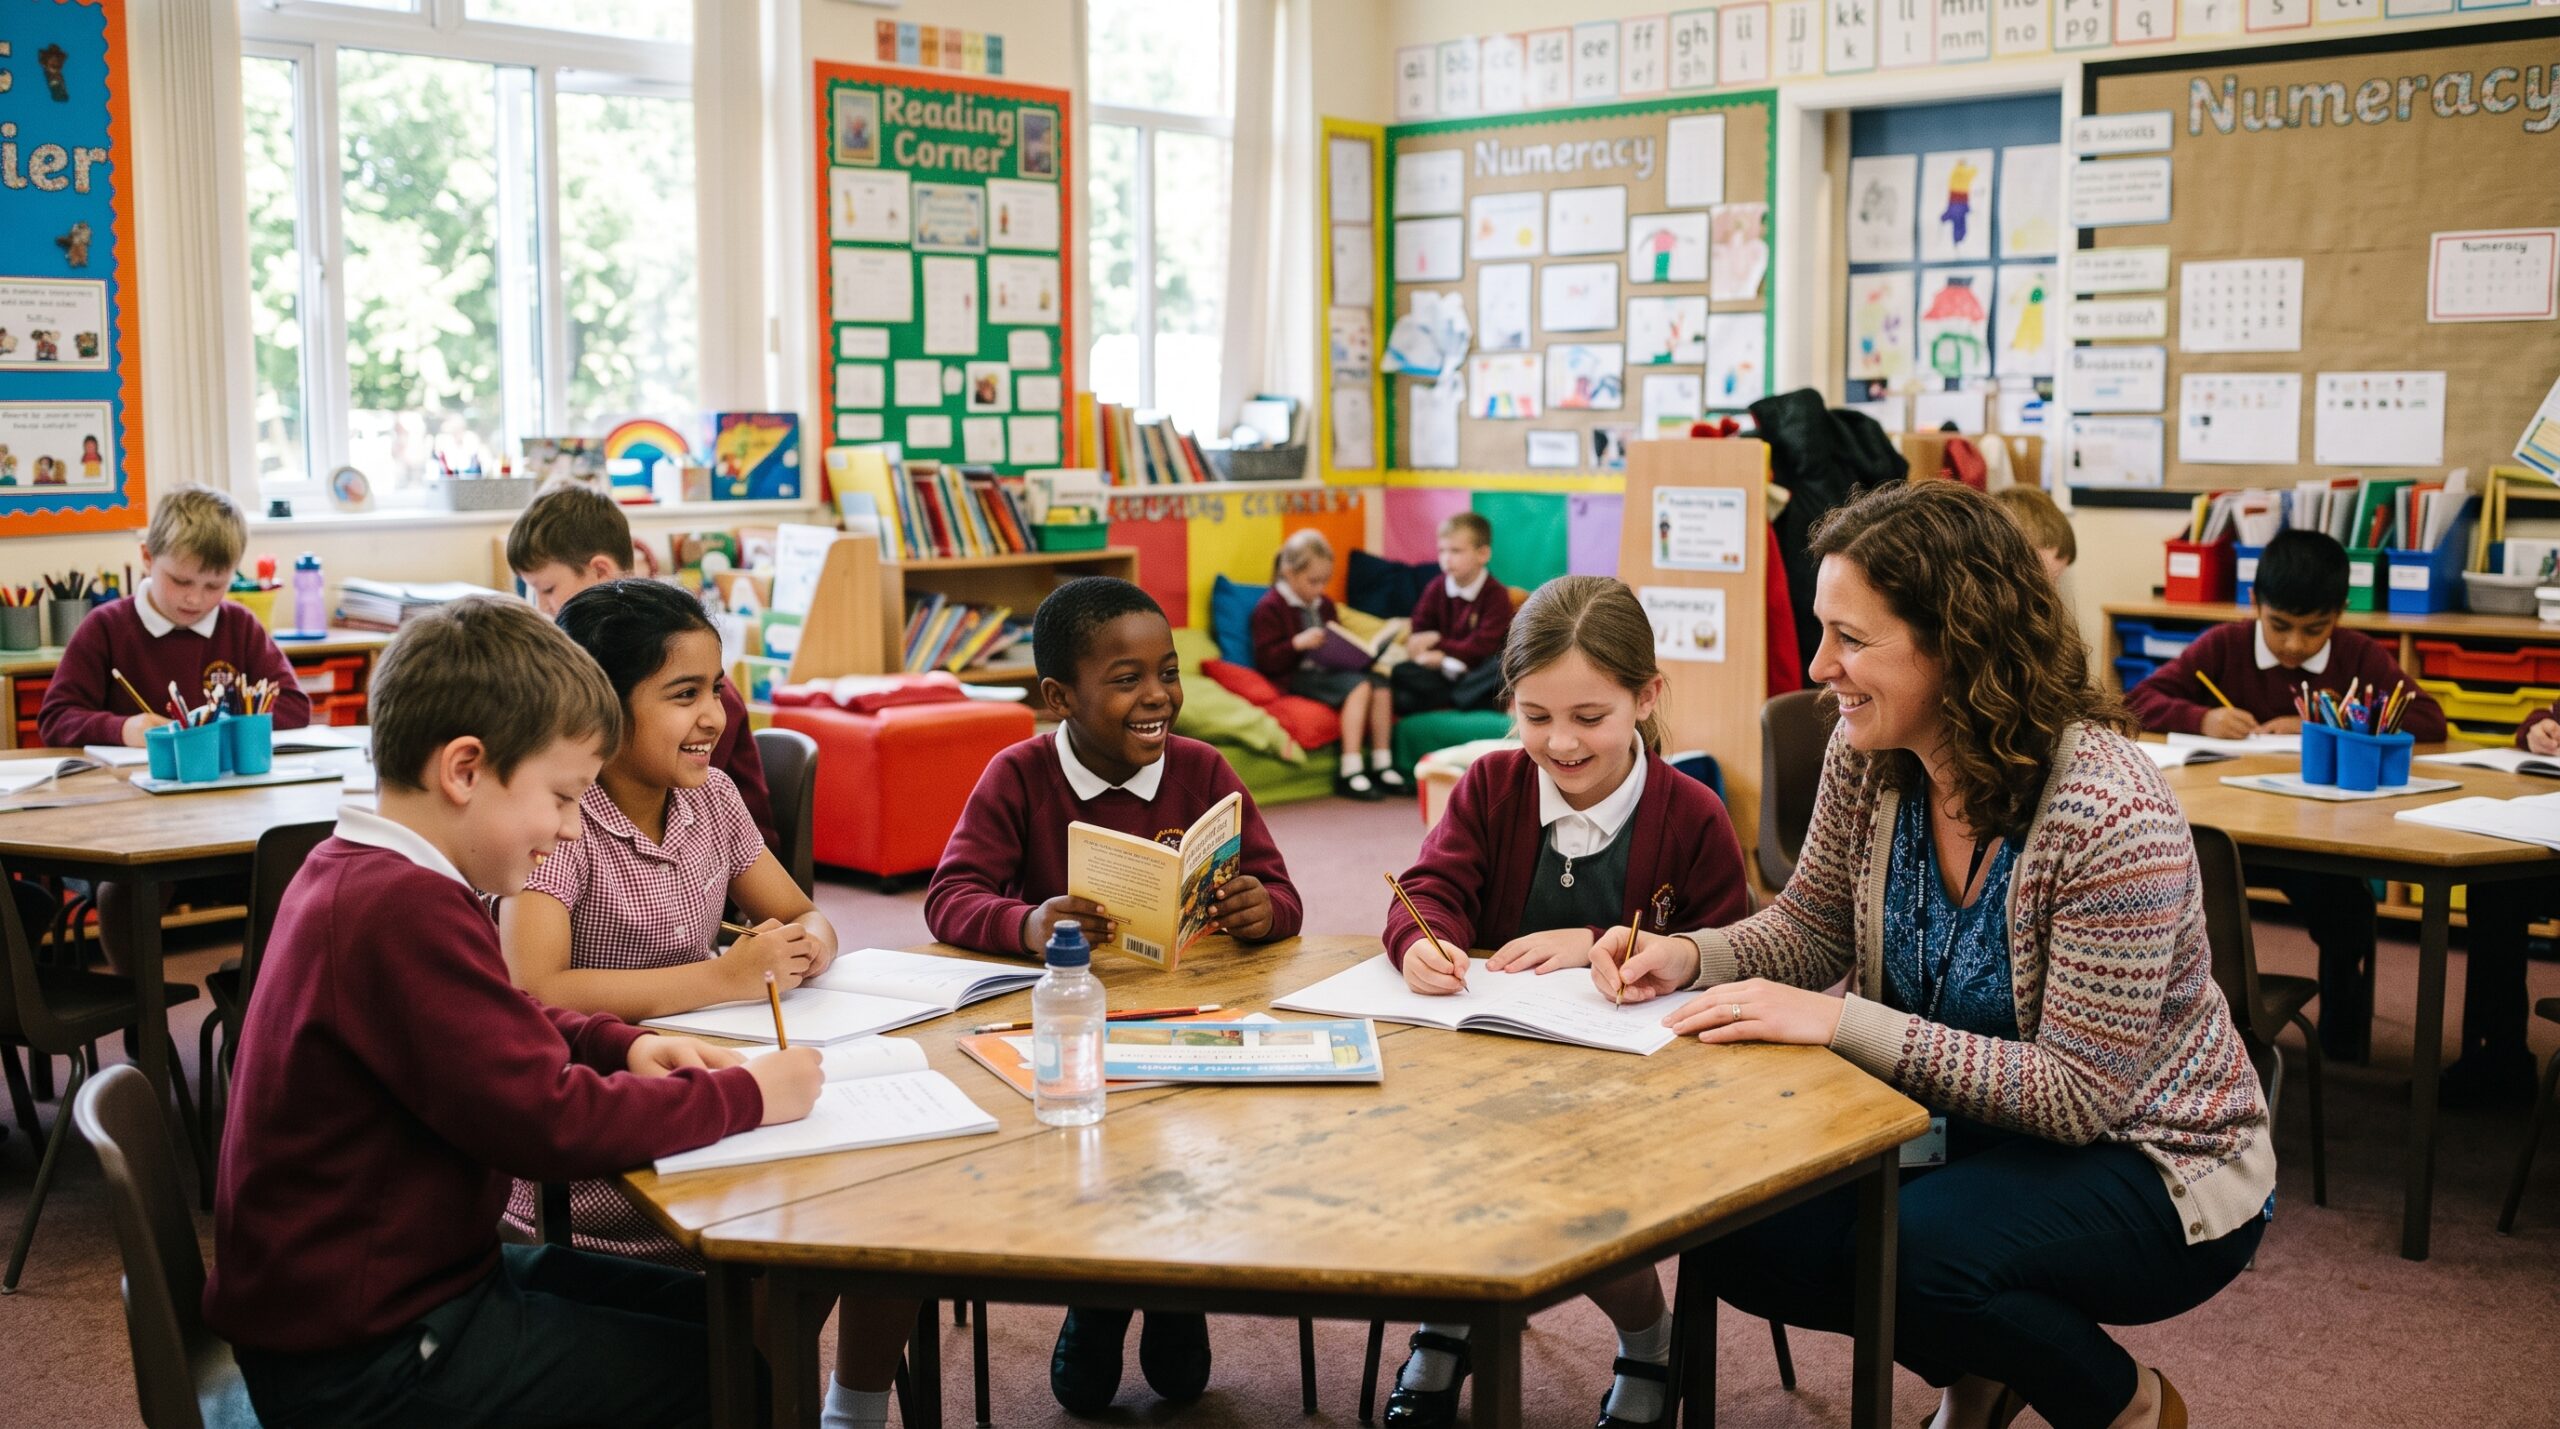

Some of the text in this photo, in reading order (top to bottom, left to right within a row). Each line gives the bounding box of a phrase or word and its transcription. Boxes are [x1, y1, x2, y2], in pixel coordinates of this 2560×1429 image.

[1677, 18, 1709, 57] gh
[882, 87, 1015, 147] Reading
[2187, 63, 2560, 135] Numeracy
[893, 130, 1005, 173] Corner
[1473, 137, 1656, 181] Numeracy
